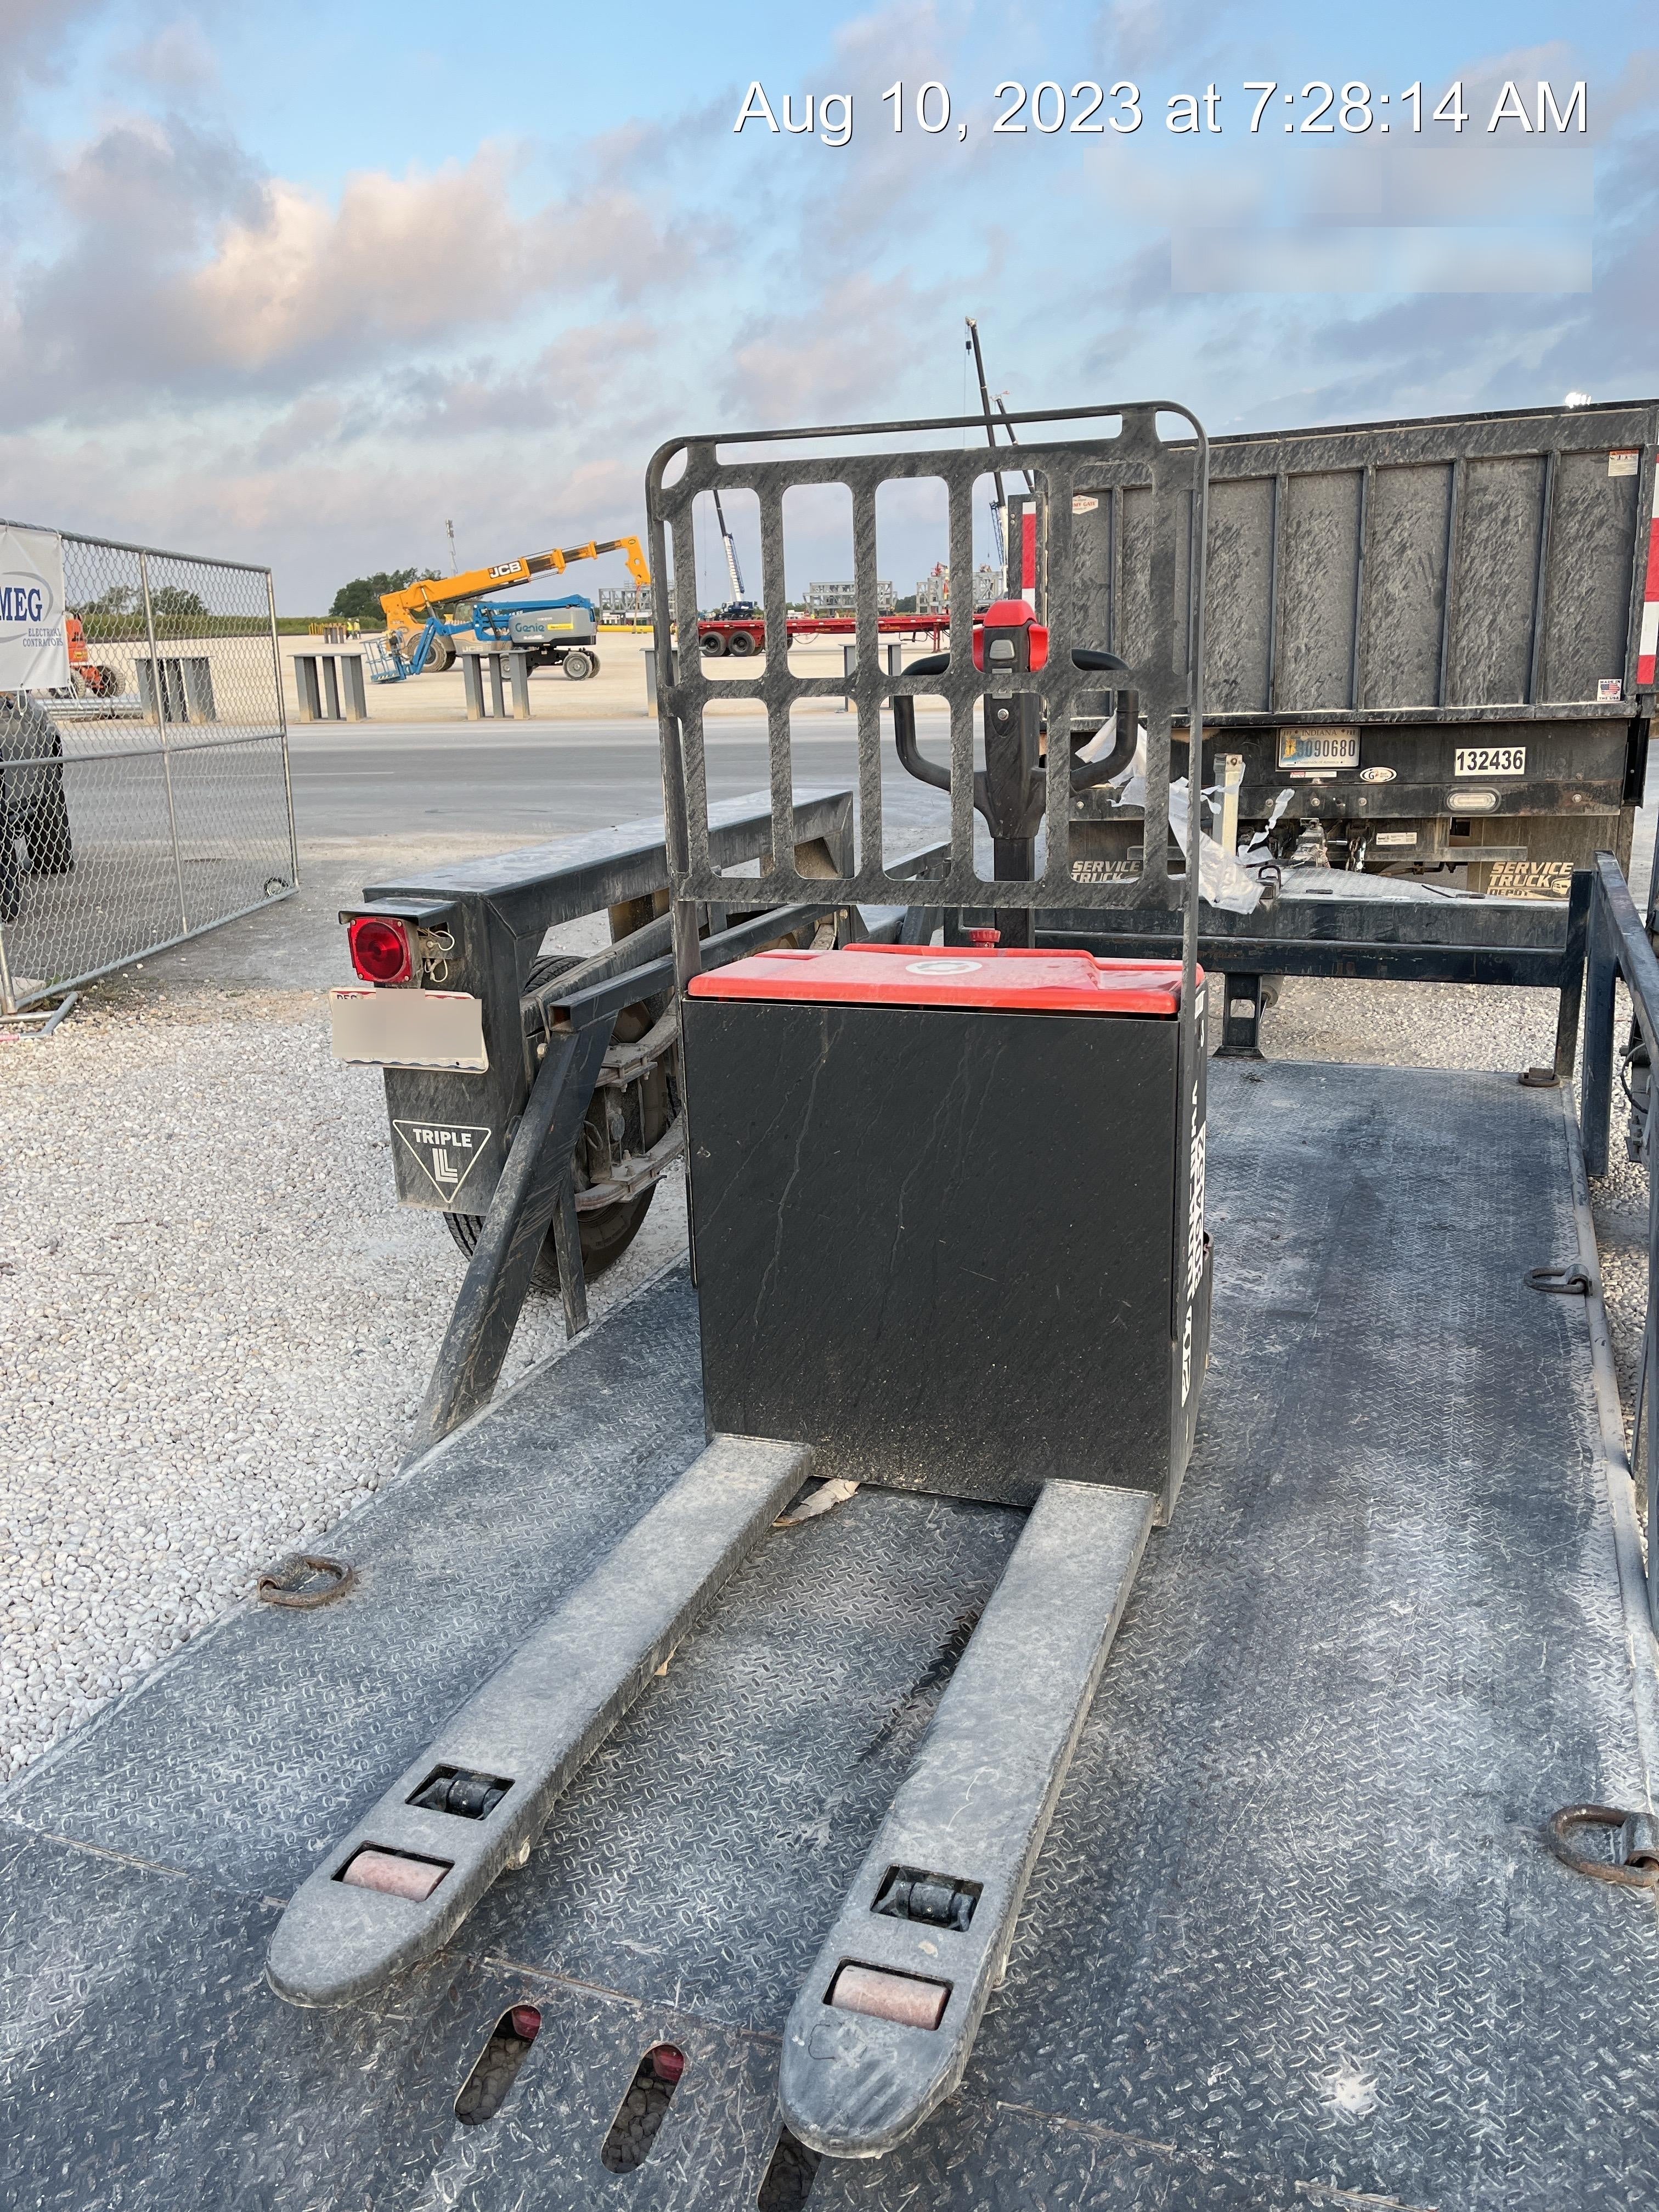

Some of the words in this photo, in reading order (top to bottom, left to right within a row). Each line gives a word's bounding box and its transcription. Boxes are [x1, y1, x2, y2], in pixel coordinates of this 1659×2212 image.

[489, 561, 522, 578] JCB
[516, 623, 545, 632] Genie
[1457, 750, 1523, 771] 132436
[1072, 860, 1141, 872] SERVICE
[1491, 862, 1574, 874] SERVICE
[1489, 874, 1551, 887] TRUCK
[413, 1128, 472, 1148] TRIPLE
